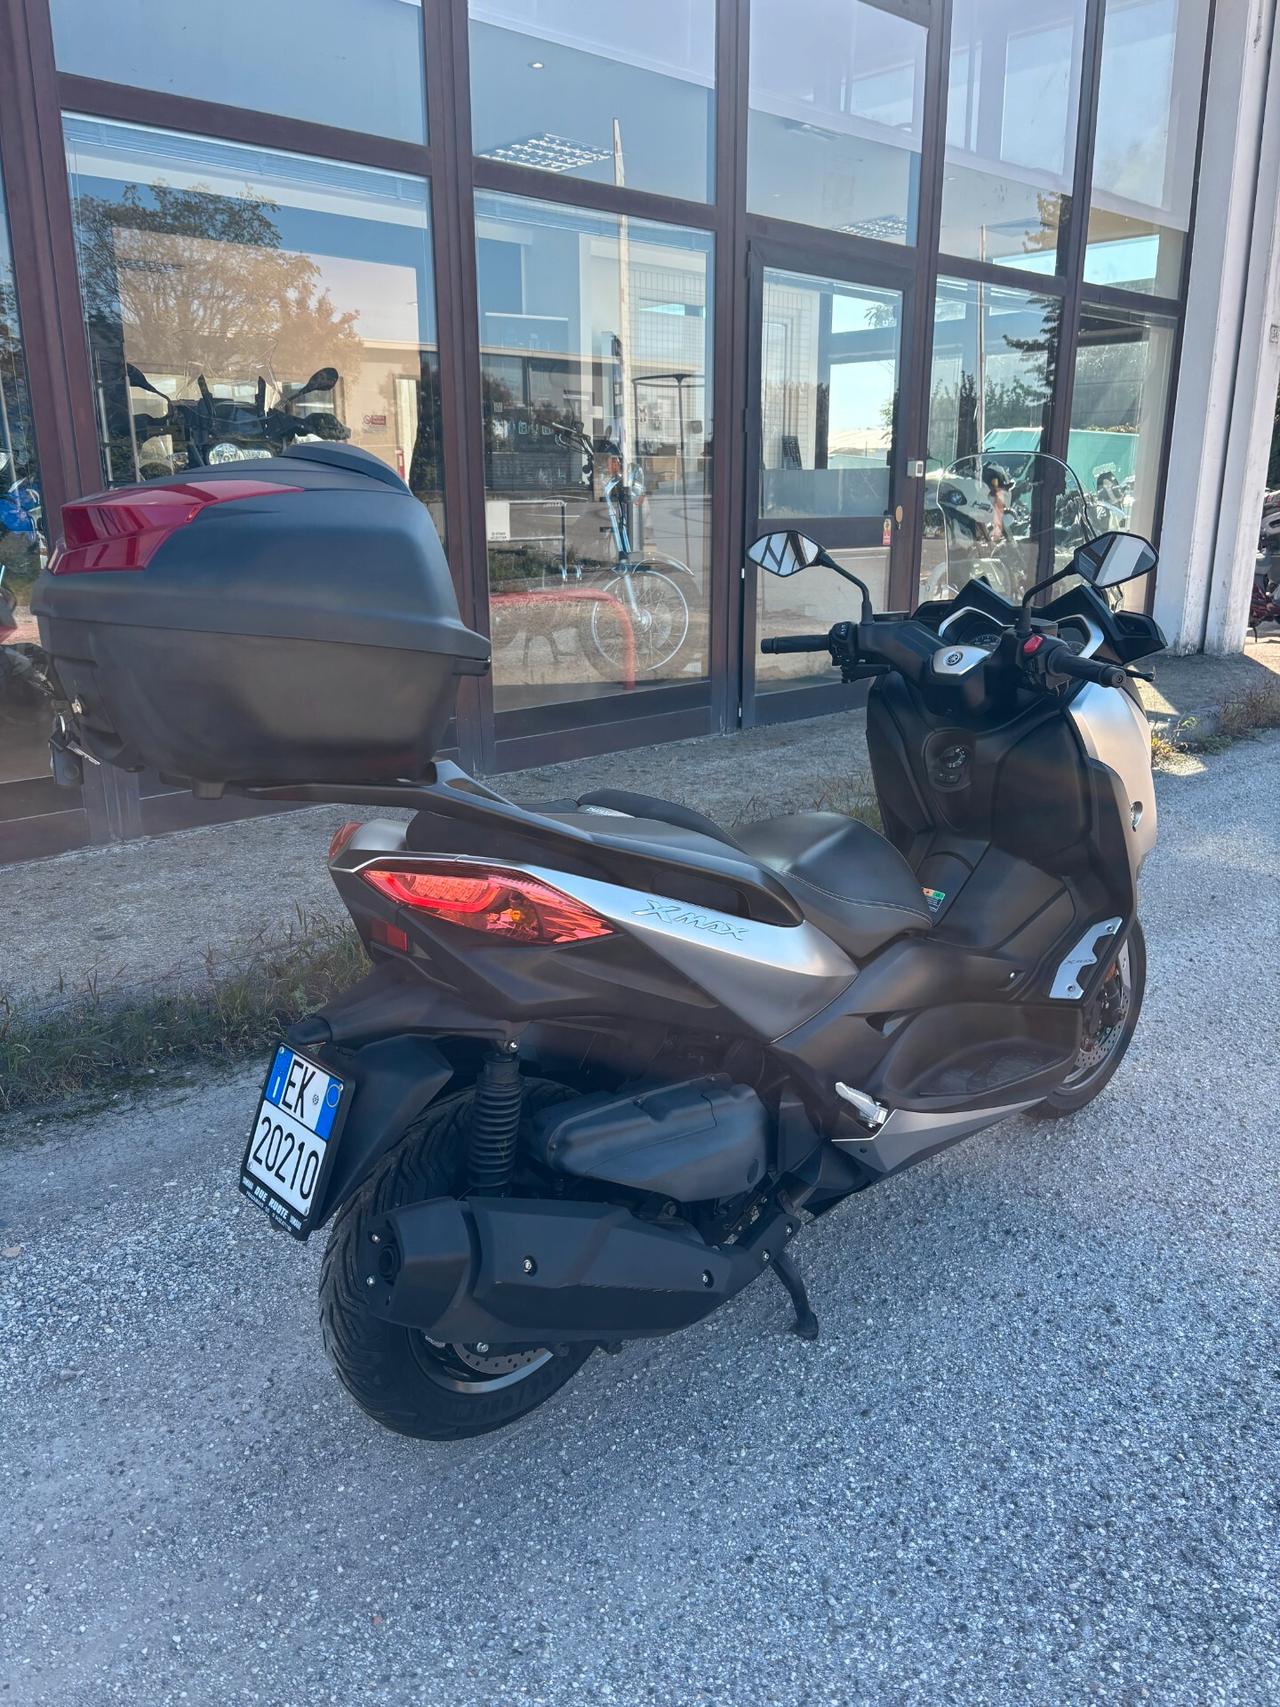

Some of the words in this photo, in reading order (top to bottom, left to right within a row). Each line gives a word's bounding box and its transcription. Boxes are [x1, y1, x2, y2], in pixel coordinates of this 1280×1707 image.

[282, 1059, 316, 1118] EK
[252, 1116, 320, 1199] 20210
[253, 1185, 268, 1202] DUE
[268, 1197, 289, 1220] RUOTE
